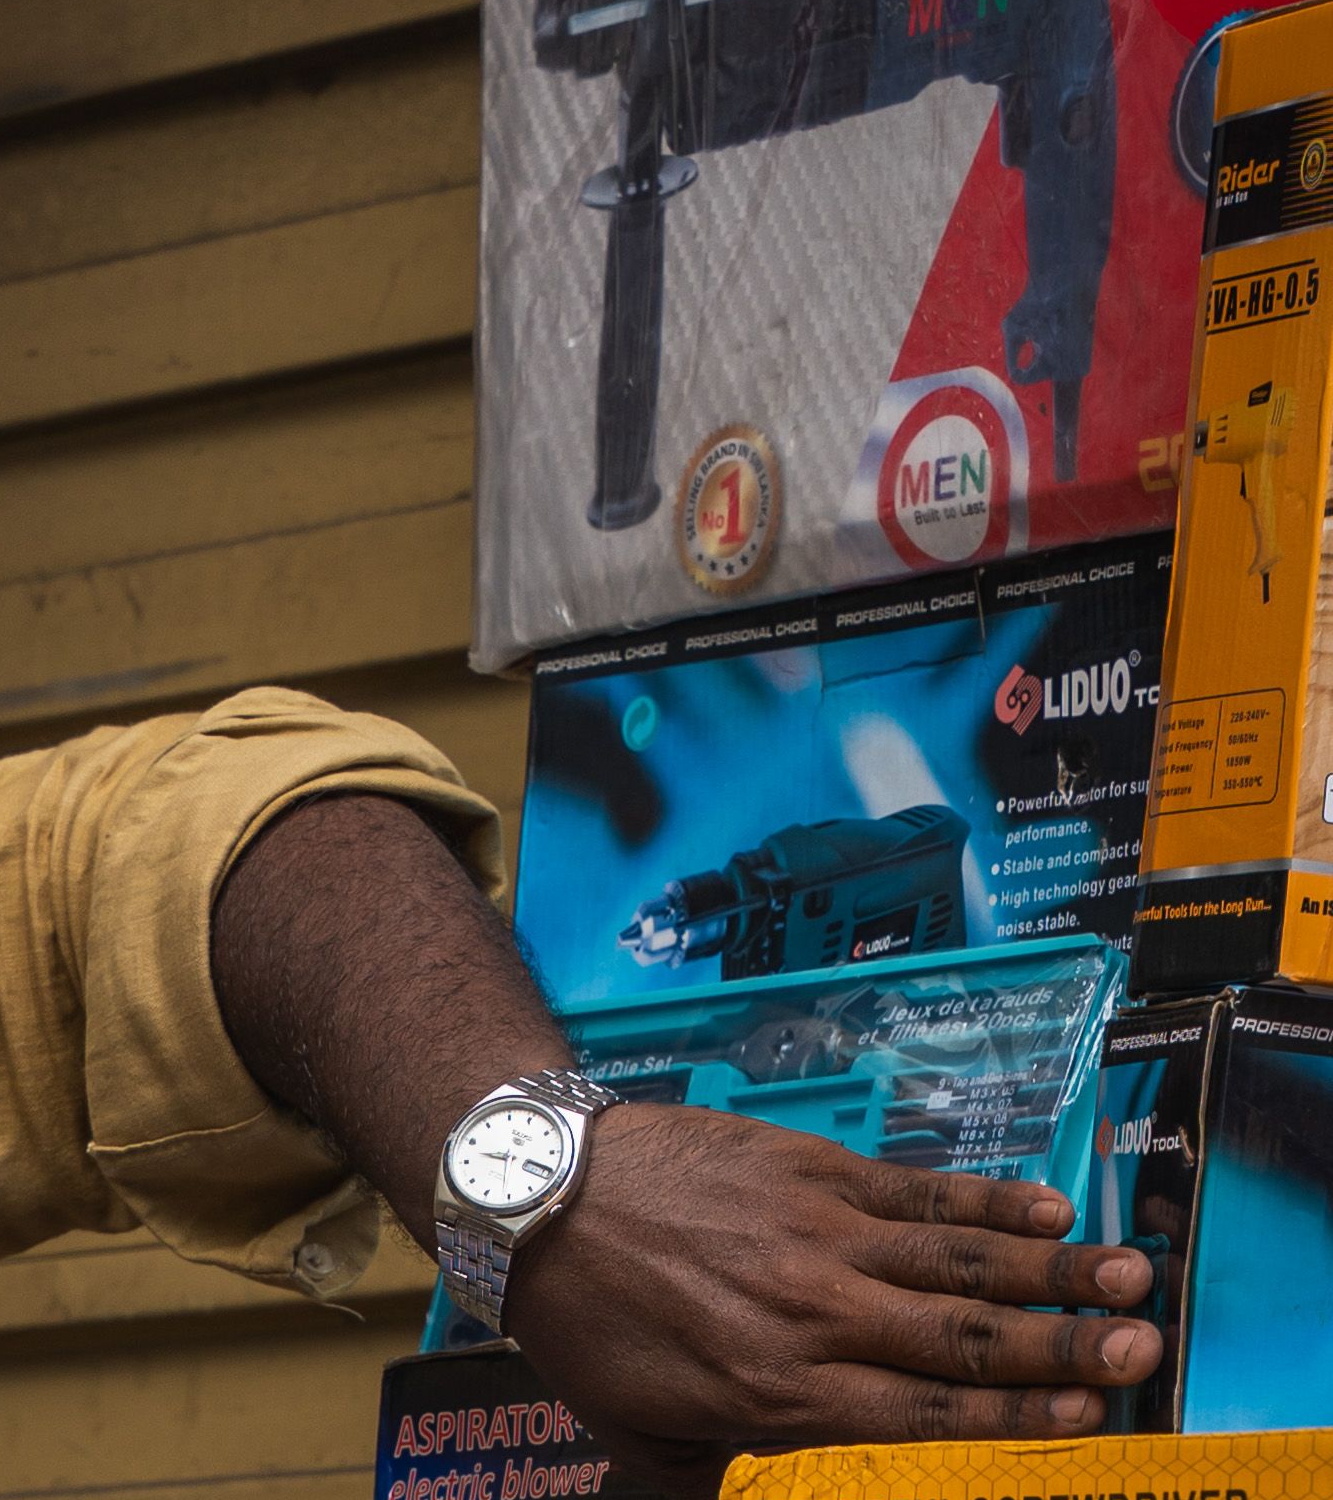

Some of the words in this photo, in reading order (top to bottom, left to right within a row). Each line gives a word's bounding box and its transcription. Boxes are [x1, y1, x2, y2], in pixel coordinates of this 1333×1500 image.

[1216, 158, 1280, 197] Rider
[901, 449, 987, 509] MEN
[959, 500, 987, 519] Last
[996, 575, 1086, 599] PROFESSIONAL
[1089, 561, 1136, 582] CHOICE
[836, 600, 928, 628] PROFESSIONAL
[930, 591, 976, 612] CHOICE
[685, 626, 773, 651] PROFESSIONAL
[775, 617, 819, 638] CHOICE
[535, 650, 622, 675] PROFESSIONAL
[625, 641, 668, 662] CHOICE
[1043, 657, 1131, 720] LIDUO
[1174, 740, 1213, 752] Frequency
[1170, 763, 1194, 774] Power
[1109, 780, 1127, 798] for
[1005, 820, 1092, 848] performance.
[1003, 856, 1044, 876] Stable
[1047, 850, 1072, 867] and
[1074, 842, 1129, 865] compact
[1000, 887, 1031, 909] High
[1033, 879, 1106, 899] technology
[1301, 896, 1320, 915] An
[1164, 903, 1188, 920] Tools
[1189, 902, 1203, 917] for
[1204, 901, 1219, 916] the
[1221, 899, 1244, 917] Long
[882, 1002, 935, 1023] Jeux
[938, 998, 965, 1016] de
[969, 987, 1054, 1013] tarauds
[858, 1028, 879, 1046] et
[1109, 1029, 1169, 1053] PROFESSIONAL
[1170, 1026, 1204, 1043] CHOICE
[610, 1059, 639, 1078] Die
[642, 1055, 674, 1074] Set
[970, 1086, 989, 1100] M3
[962, 1115, 980, 1128] M5
[1113, 1114, 1153, 1156] LIDUO
[954, 1143, 973, 1156] M7
